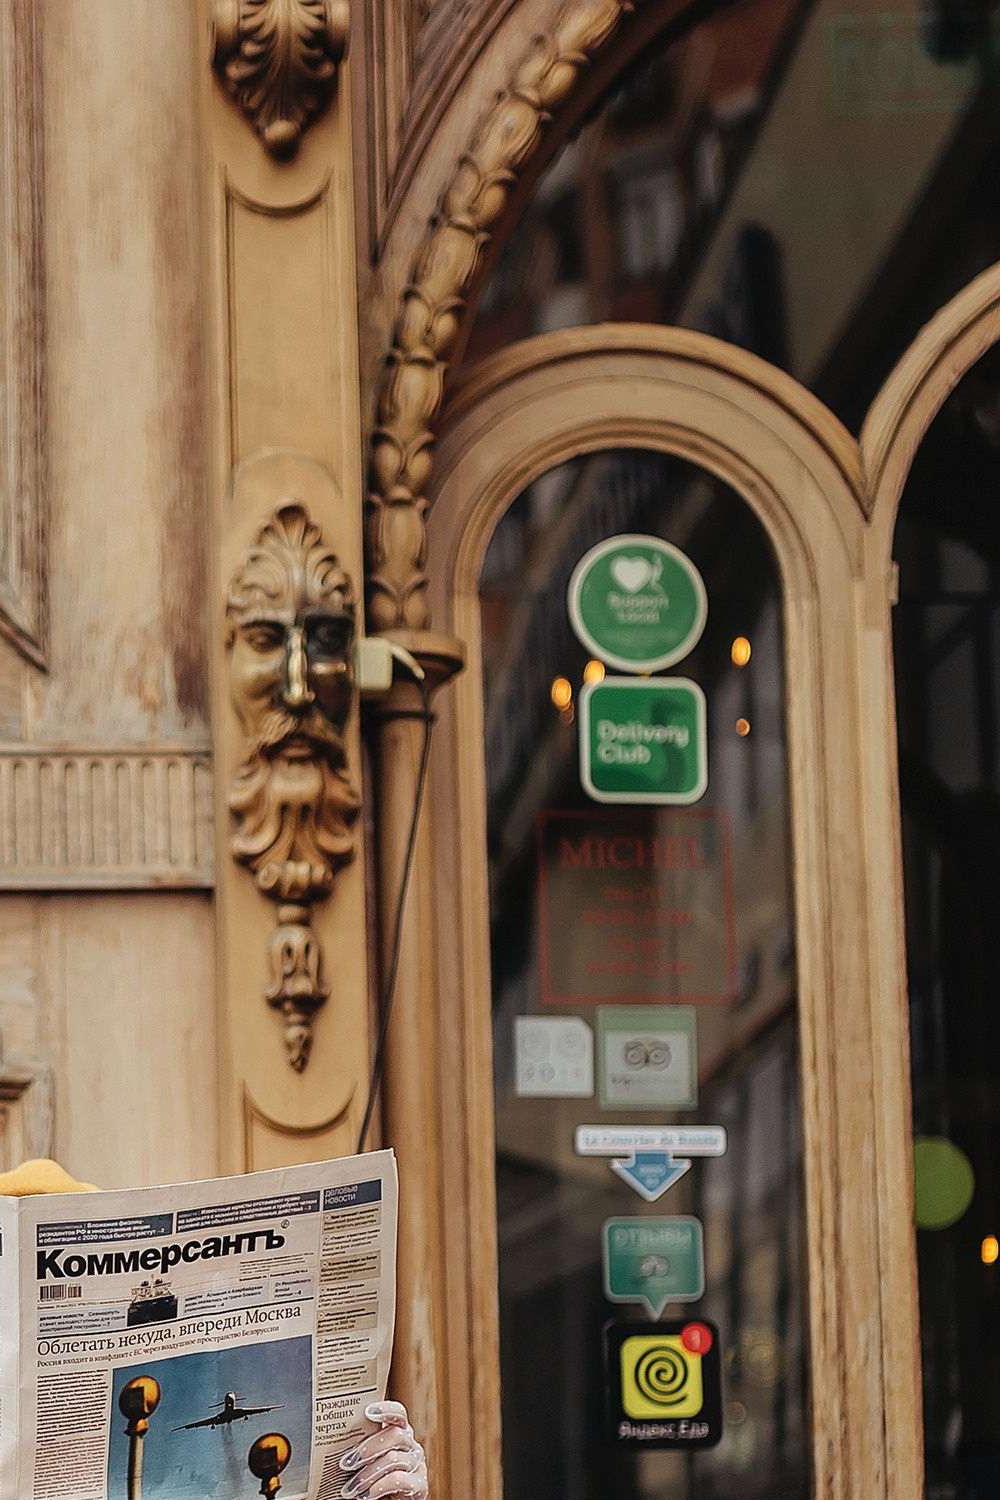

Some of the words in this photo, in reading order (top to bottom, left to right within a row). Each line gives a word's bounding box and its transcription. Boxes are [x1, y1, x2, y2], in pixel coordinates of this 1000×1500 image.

[597, 718, 690, 748] Delivery
[597, 743, 651, 764] Club
[560, 837, 710, 869] MICHEL
[325, 1185, 358, 1198] деловые
[325, 1193, 356, 1205] новости
[39, 1230, 75, 1238] резидентов
[91, 1226, 132, 1234] иностранные
[114, 1231, 136, 1239] быстро
[136, 1229, 156, 1237] растут
[37, 1229, 285, 1280] Коммерсантъ
[37, 1338, 115, 1356] Облетать
[119, 1326, 176, 1347] некуда,
[179, 1315, 242, 1336] впереди
[245, 1305, 301, 1325] Москва
[37, 1359, 62, 1368] Россия
[62, 1357, 88, 1365] входит
[94, 1353, 128, 1361] конфликт
[143, 1347, 160, 1355] через
[161, 1339, 196, 1351] воздушное
[196, 1331, 241, 1344] пространство
[242, 1325, 280, 1337] Белоруссии
[316, 1397, 361, 1413] Граждане
[323, 1409, 354, 1421] общих
[315, 1421, 347, 1433] чертах
